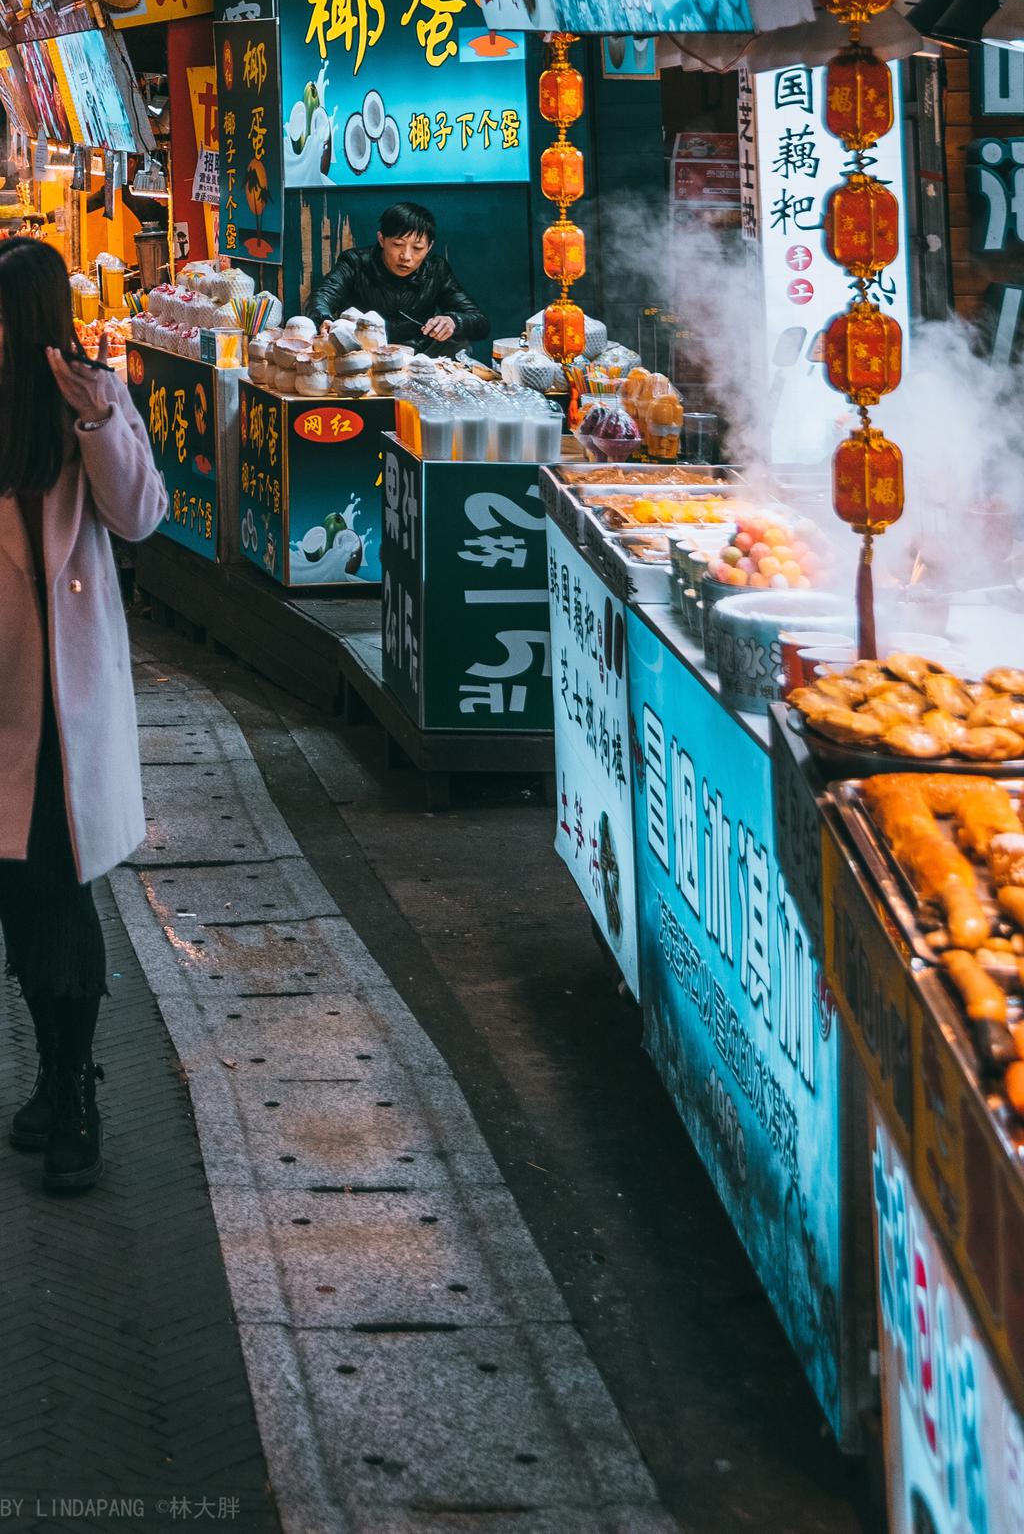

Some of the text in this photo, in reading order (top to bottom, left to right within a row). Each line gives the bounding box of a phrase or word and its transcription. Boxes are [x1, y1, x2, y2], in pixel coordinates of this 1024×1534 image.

[242, 39, 269, 162] 椰蛋
[408, 109, 522, 151] 椰子下个蛋
[223, 110, 239, 250] 椰子下个蛋
[148, 377, 189, 464] 椰蛋
[249, 396, 280, 467] 椰蛋
[303, 412, 354, 437] 网红
[172, 488, 213, 541] 椰子下个蛋
[241, 461, 281, 515] 椰子下个蛋
[549, 545, 598, 662] 韩国藕粑
[560, 644, 627, 803] 芝士热狗棒
[642, 701, 816, 1094] 冒烟冰淇淋
